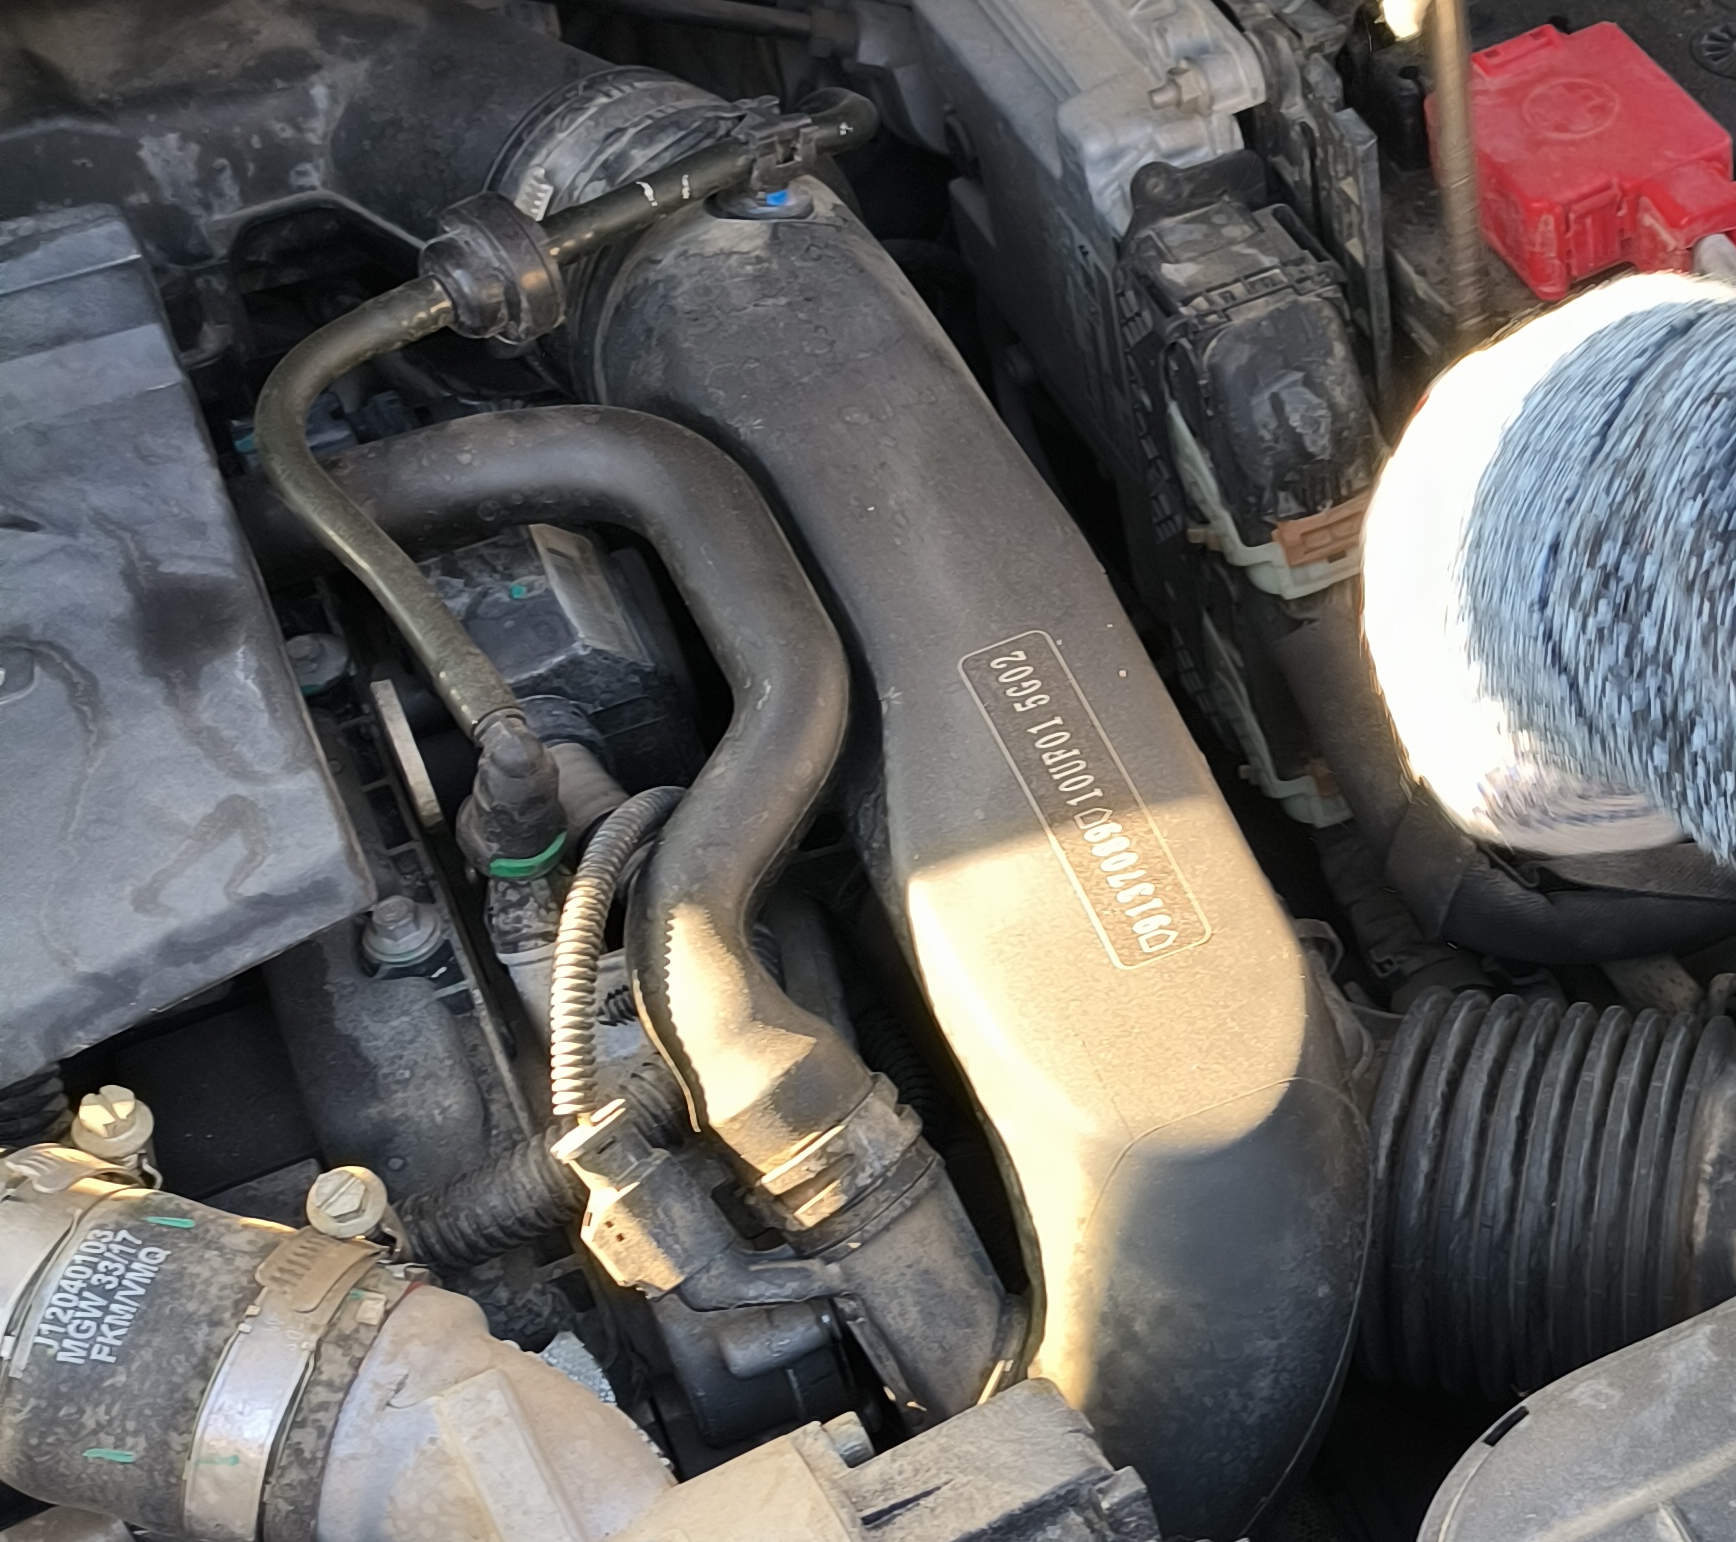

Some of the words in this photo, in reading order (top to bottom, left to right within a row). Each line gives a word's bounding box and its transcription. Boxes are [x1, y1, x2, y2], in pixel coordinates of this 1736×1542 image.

[989, 647, 1050, 712] 5G02
[31, 1227, 114, 1352] J12040103
[55, 1289, 108, 1364] MGW
[89, 1228, 142, 1290] 33/17
[88, 1245, 172, 1363] FKM/VMQ
